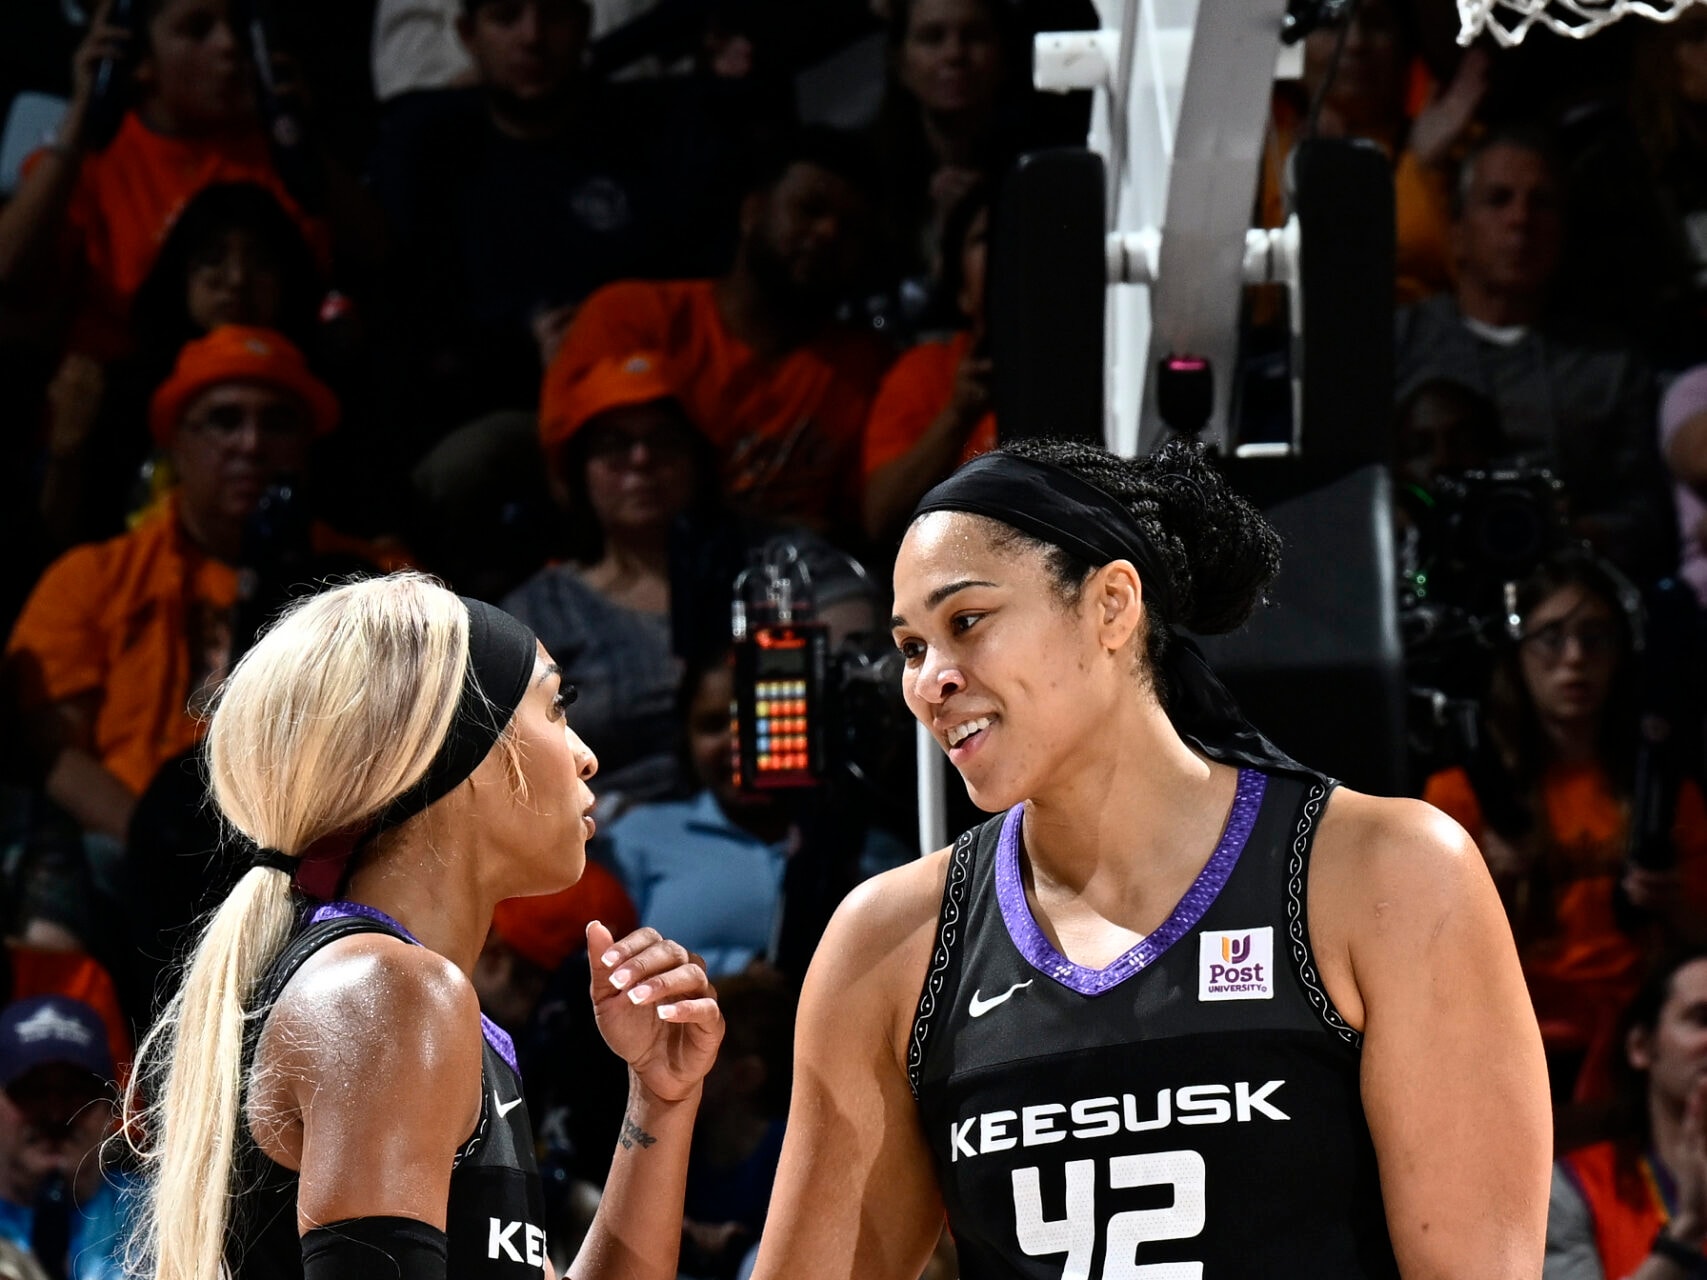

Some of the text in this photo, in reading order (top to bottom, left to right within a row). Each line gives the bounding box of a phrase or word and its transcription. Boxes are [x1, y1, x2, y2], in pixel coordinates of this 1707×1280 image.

[1209, 963, 1264, 984] Post
[951, 1080, 1291, 1162] KEESUSK
[488, 1216, 548, 1268] KE
